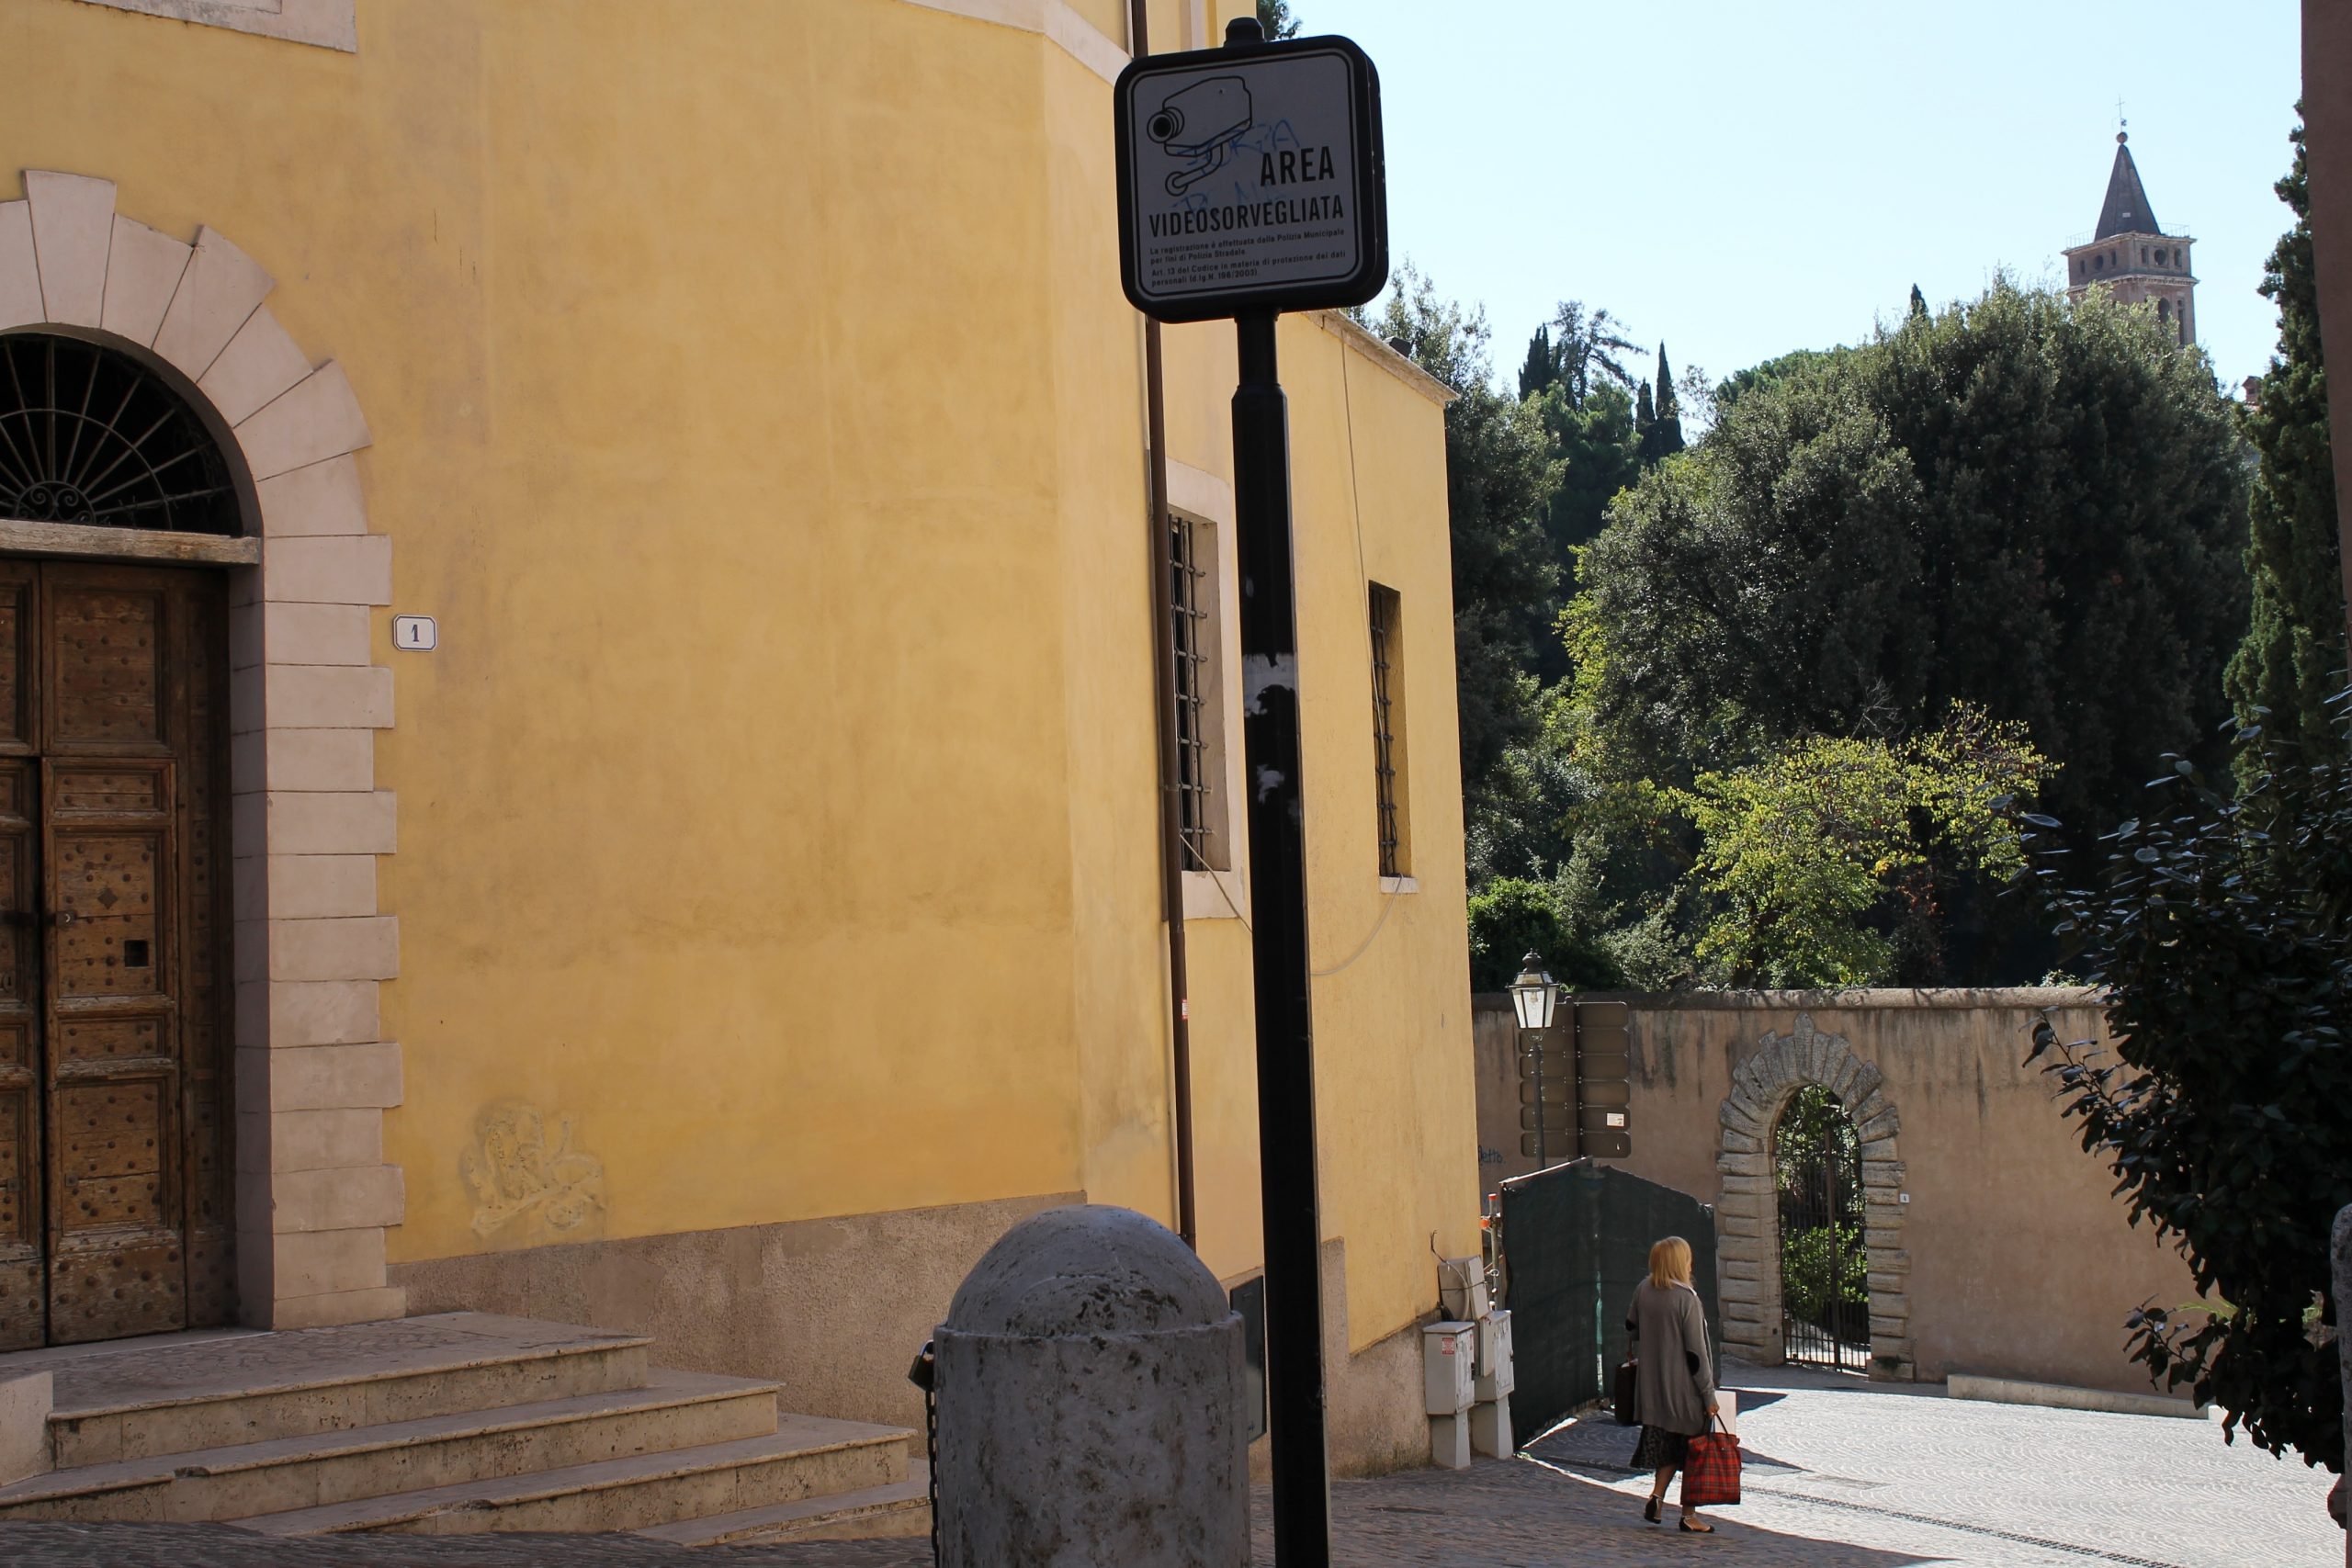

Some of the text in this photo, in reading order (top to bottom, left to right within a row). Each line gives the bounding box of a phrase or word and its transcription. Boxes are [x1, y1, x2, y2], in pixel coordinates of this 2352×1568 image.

[1260, 145, 1335, 187] AREA
[1148, 194, 1344, 238] VIDEOSORVEGLIATA
[1160, 243, 1209, 254] registrazione
[1218, 238, 1254, 247] effettuata
[1277, 232, 1302, 242] Polizia
[1304, 228, 1345, 238] Municipale
[1192, 264, 1218, 273] Codice
[1230, 258, 1260, 268] materia
[1272, 254, 1313, 265] protezione
[1316, 252, 1329, 260] dei
[1330, 250, 1346, 258] dati
[1151, 276, 1187, 288] personali
[411, 624, 420, 642] 1
